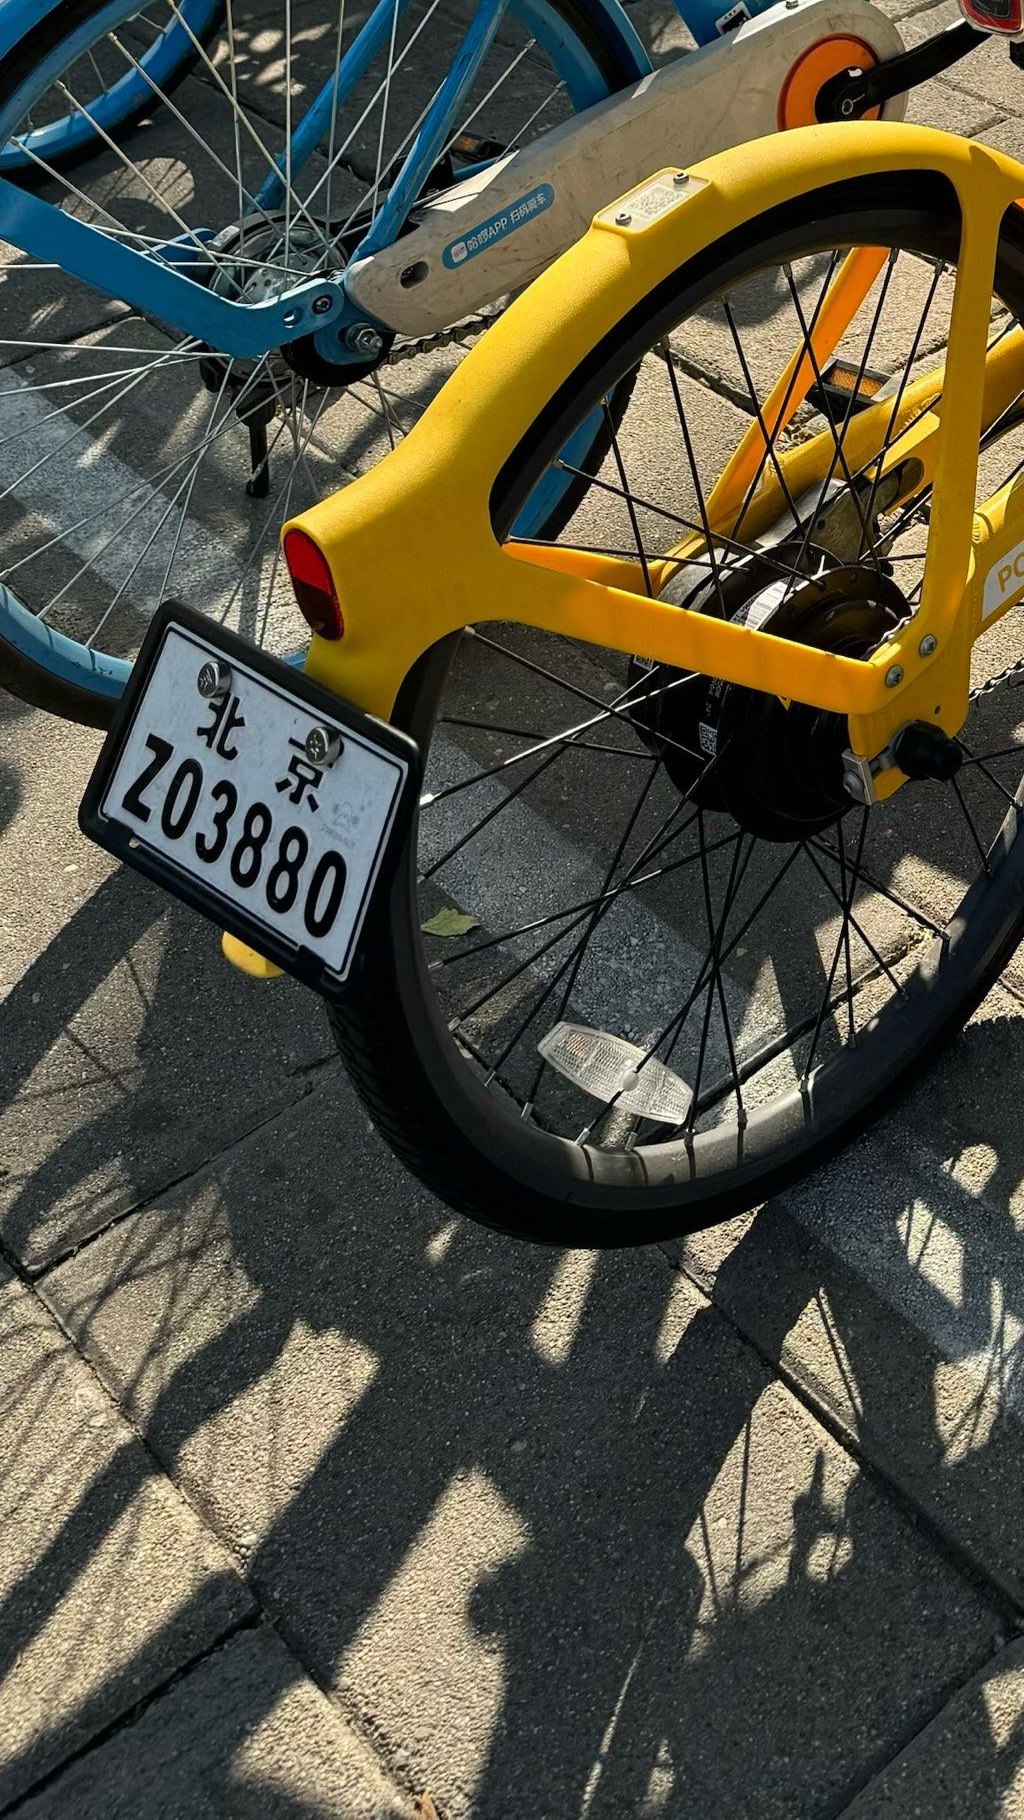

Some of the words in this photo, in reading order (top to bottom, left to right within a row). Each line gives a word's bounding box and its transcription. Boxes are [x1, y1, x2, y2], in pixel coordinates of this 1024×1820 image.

[466, 217, 508, 251] 哈啰APP
[196, 691, 246, 761] 北
[121, 732, 348, 939] Z03880
